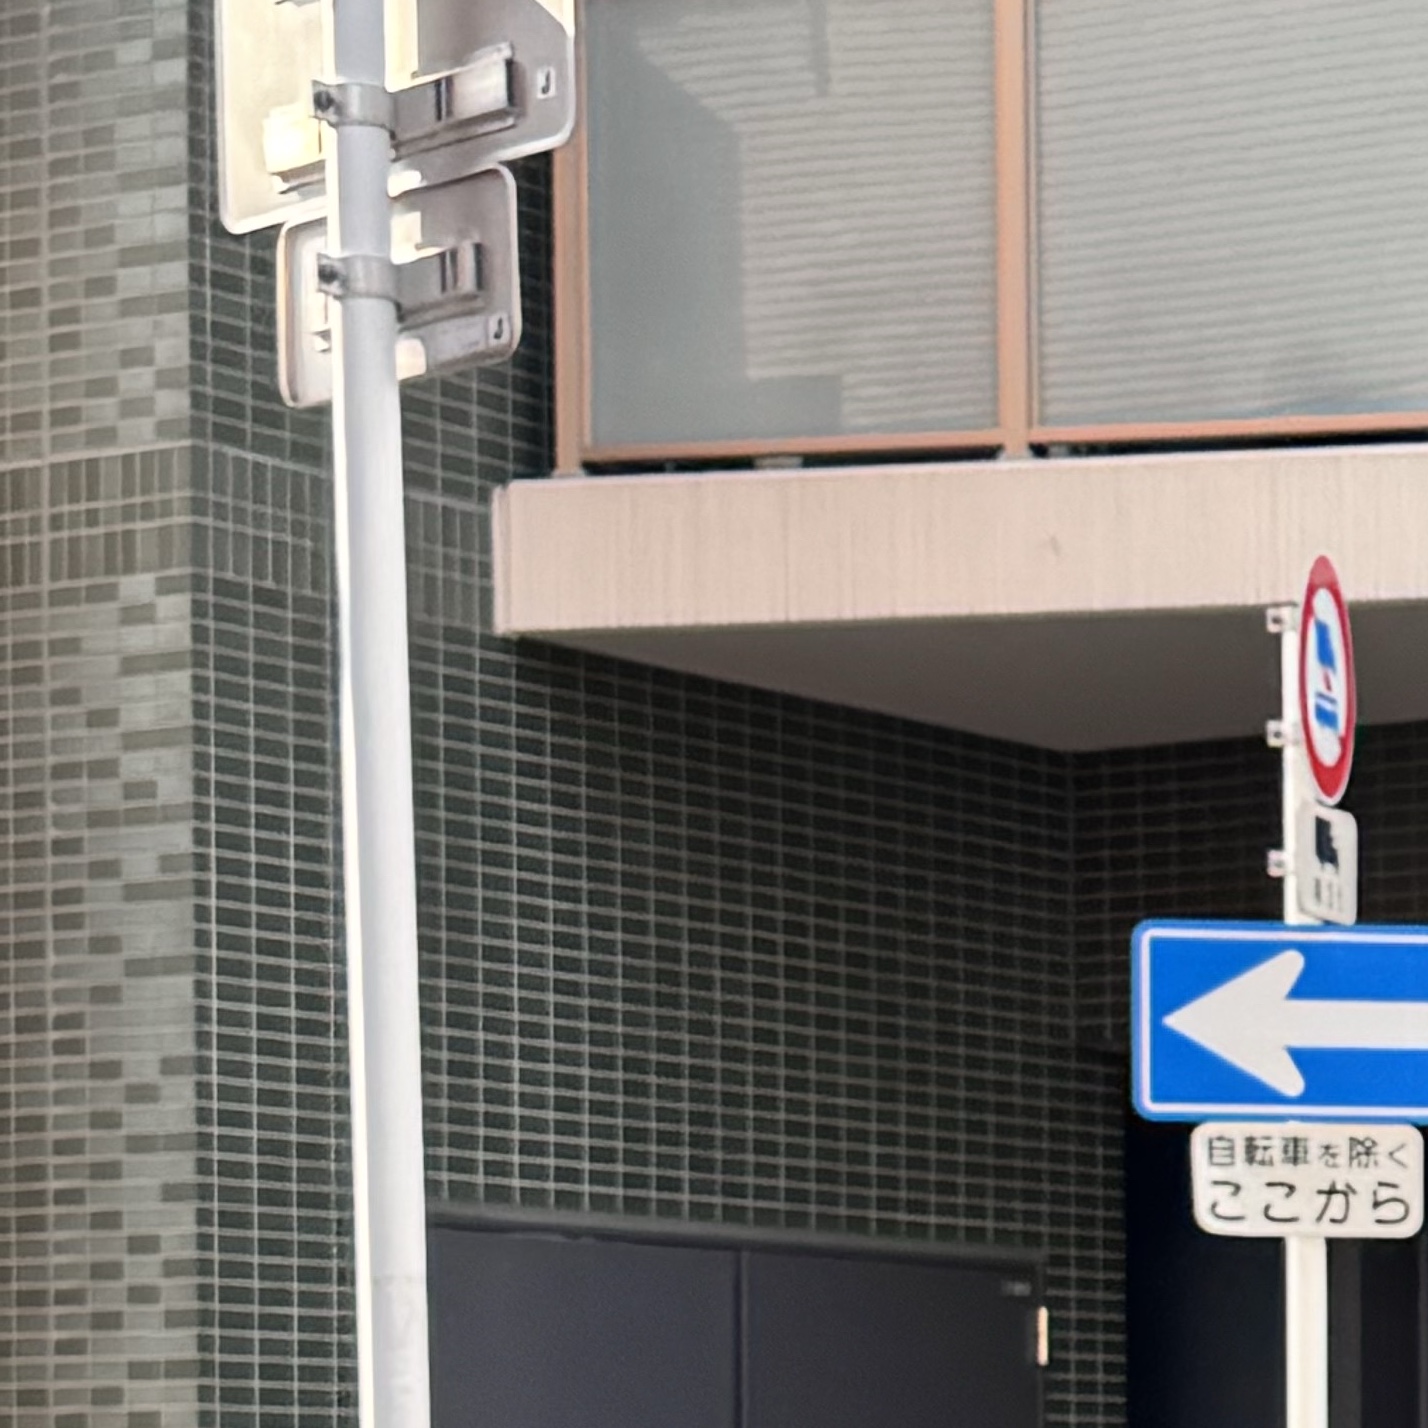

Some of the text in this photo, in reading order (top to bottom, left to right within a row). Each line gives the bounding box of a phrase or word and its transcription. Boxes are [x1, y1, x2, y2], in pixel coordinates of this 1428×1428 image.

[1208, 1134, 1409, 1169] 自転車を除く
[1210, 1180, 1410, 1224] ここから
